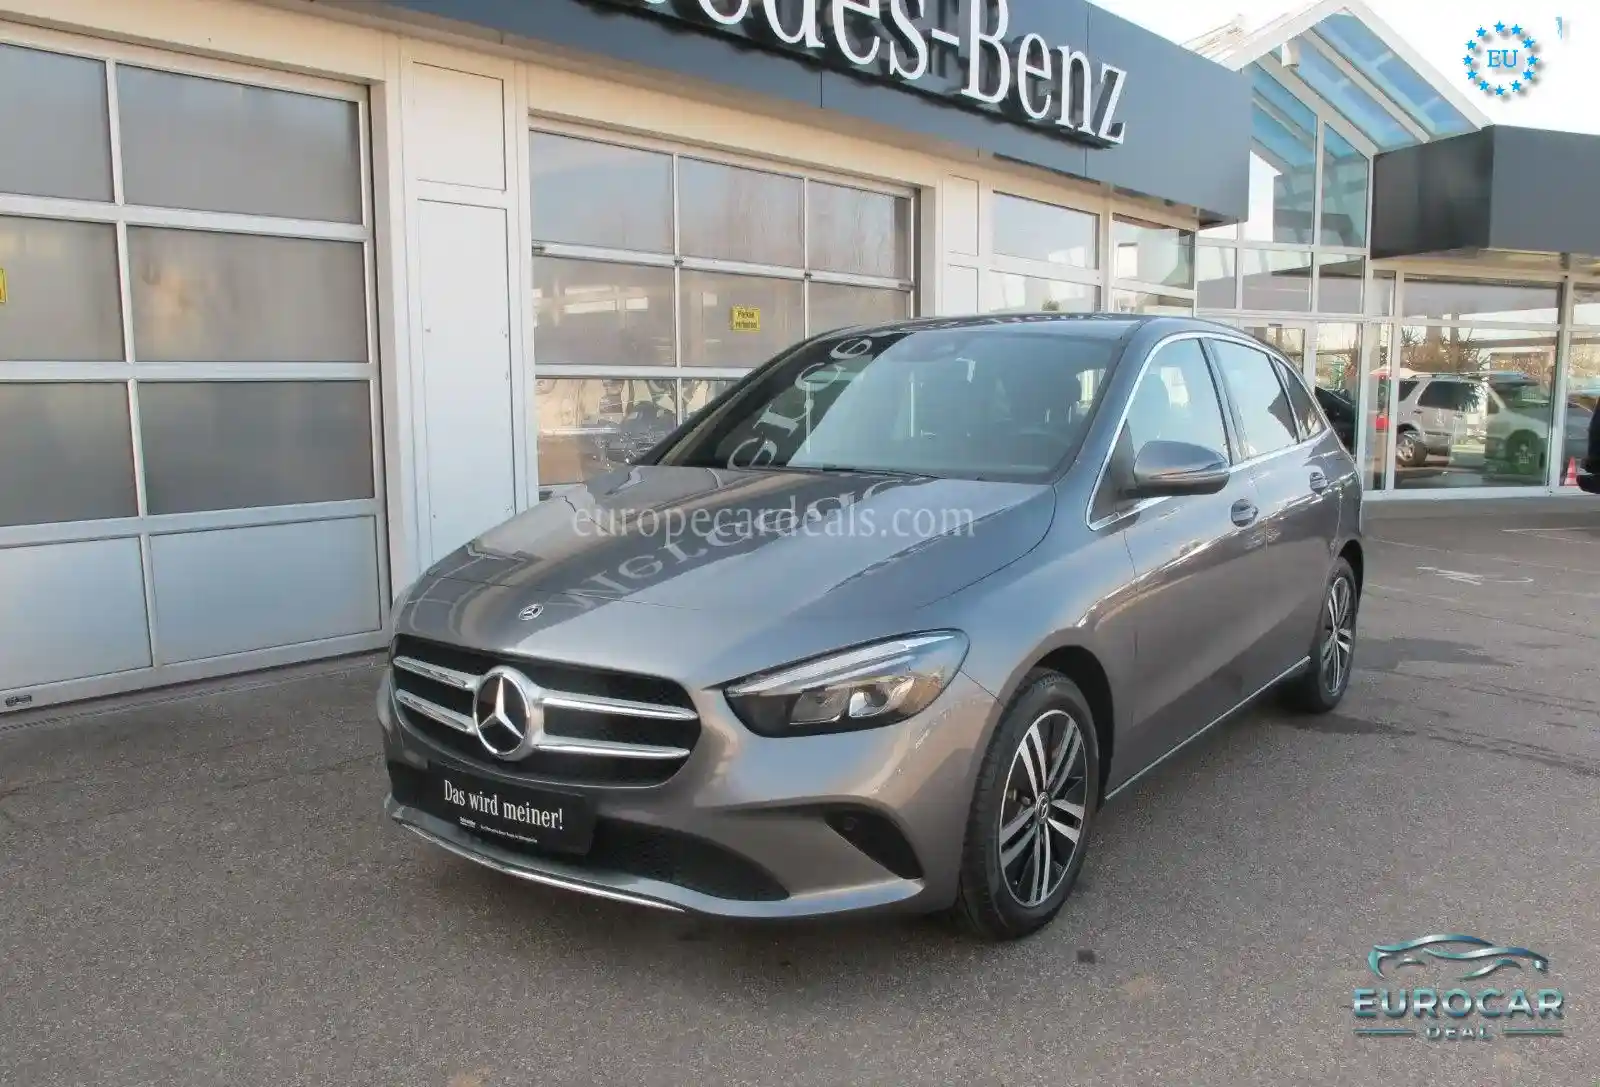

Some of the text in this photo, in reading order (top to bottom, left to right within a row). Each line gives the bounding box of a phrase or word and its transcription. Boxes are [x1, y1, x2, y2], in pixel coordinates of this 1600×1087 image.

[444, 779, 466, 806] Das
[468, 791, 499, 816] wird
[503, 801, 564, 830] meiner!
